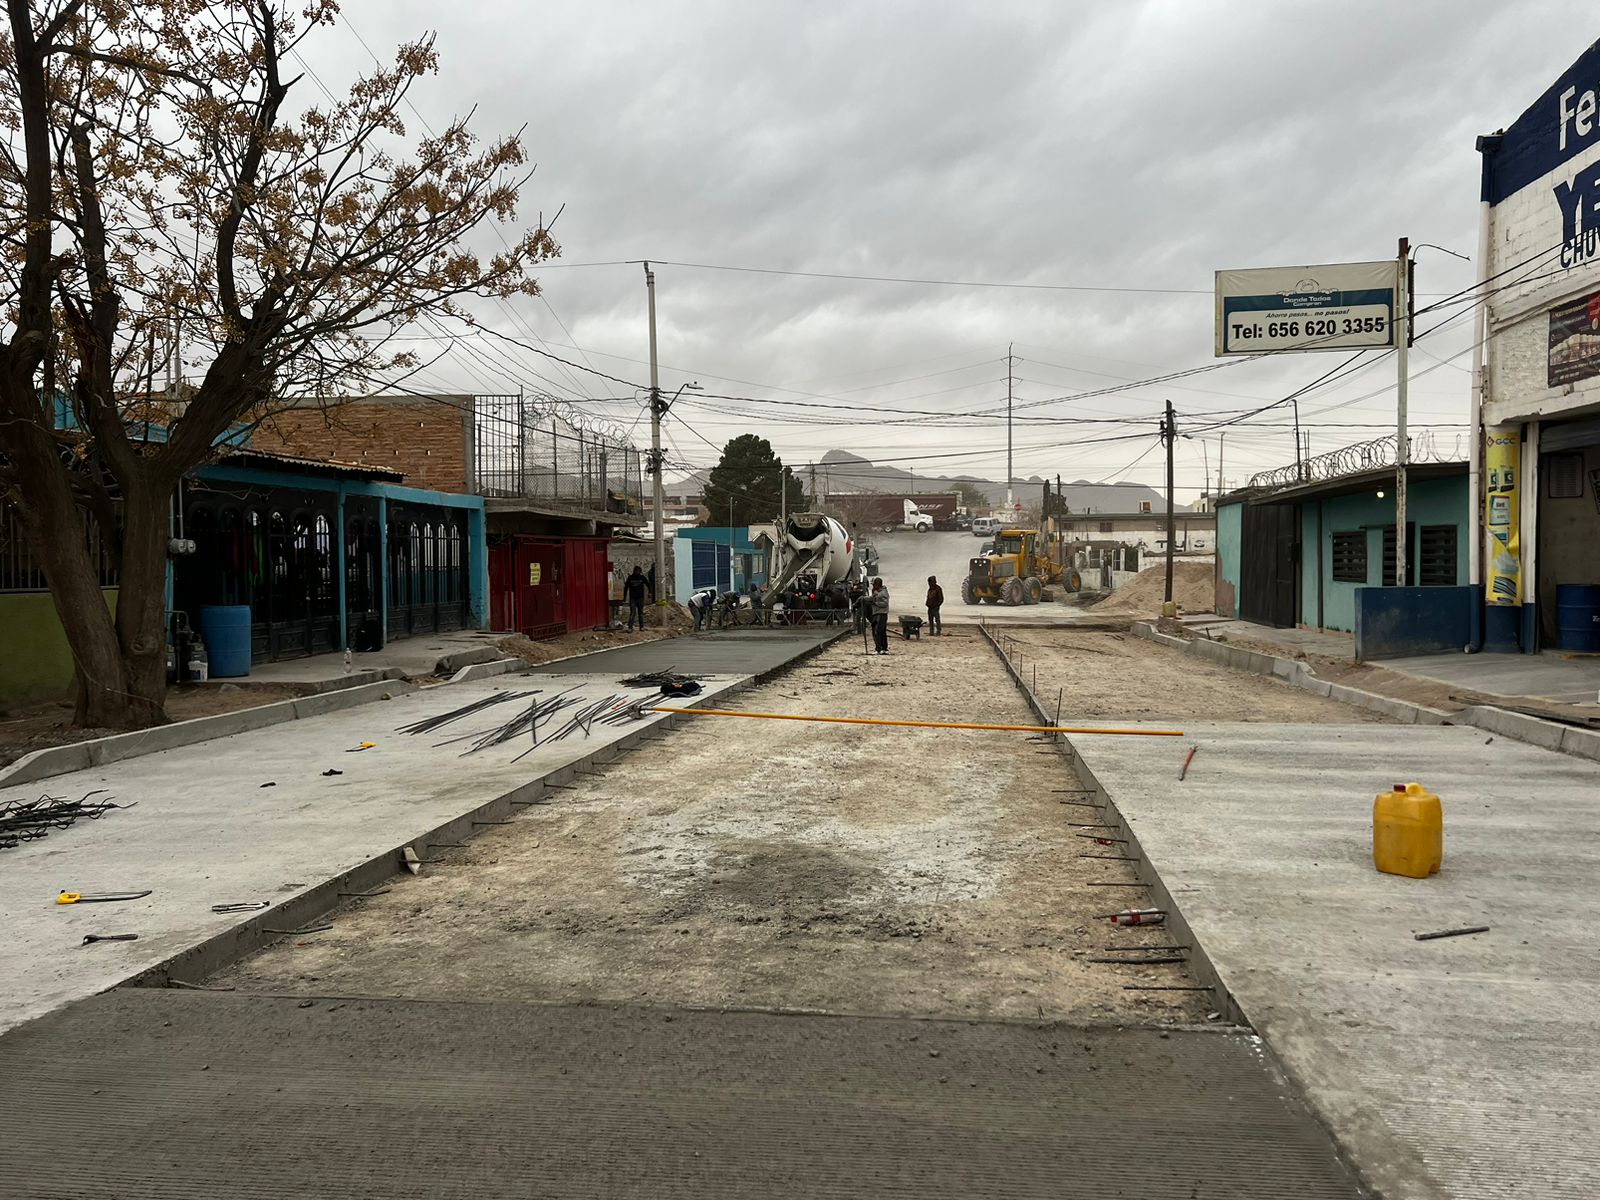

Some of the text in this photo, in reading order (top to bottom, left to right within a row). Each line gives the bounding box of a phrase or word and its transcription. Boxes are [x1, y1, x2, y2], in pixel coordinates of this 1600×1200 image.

[1559, 83, 1600, 151] Fe
[1561, 226, 1600, 268] CHU
[1232, 317, 1385, 339] Tel: 656 620 3355
